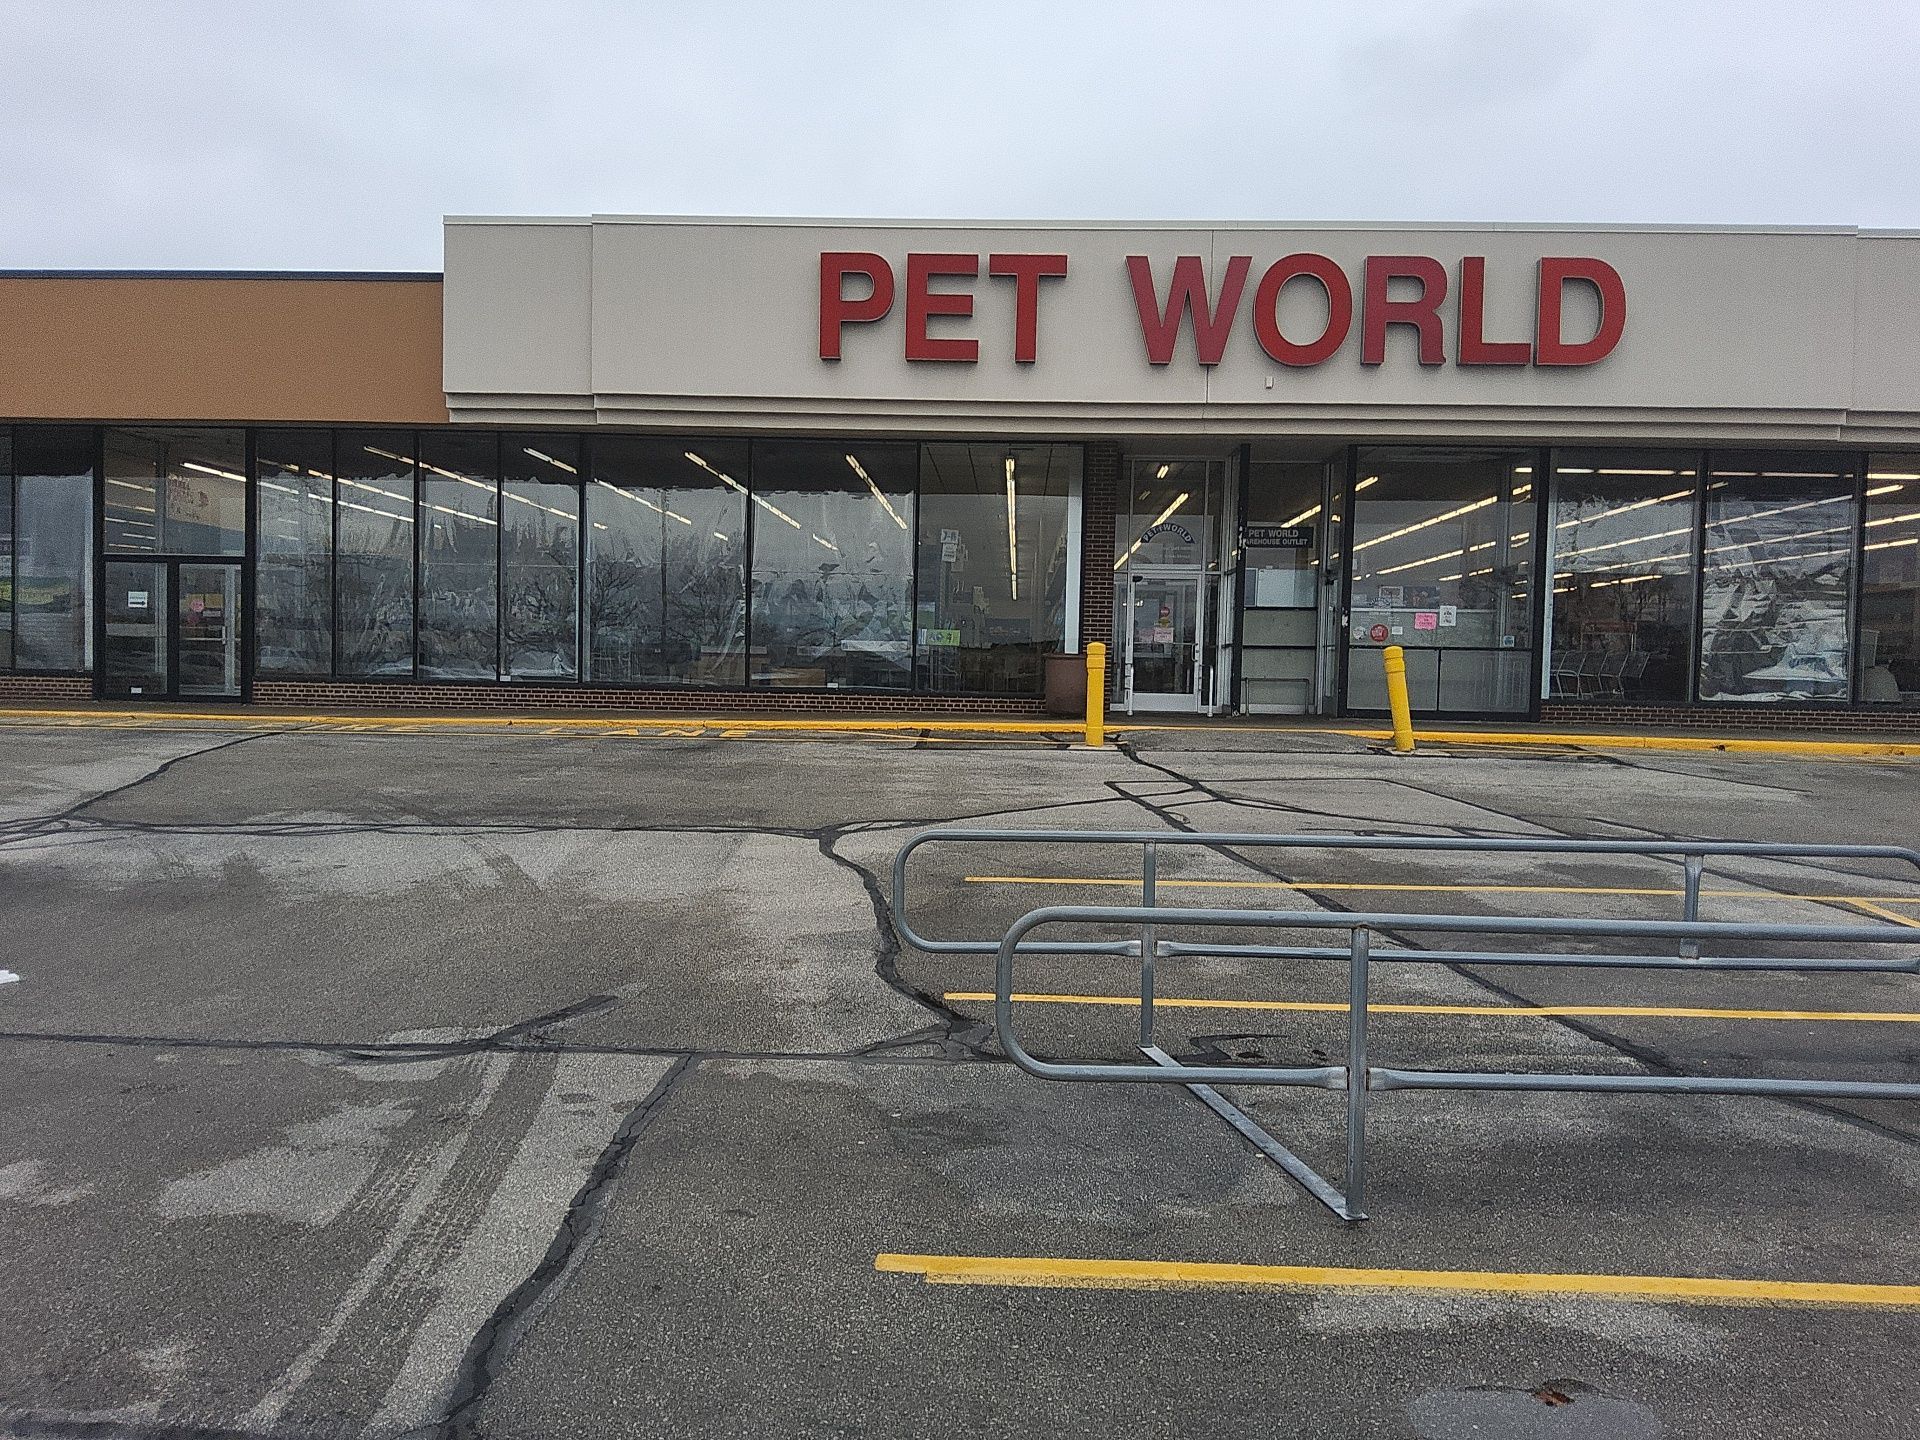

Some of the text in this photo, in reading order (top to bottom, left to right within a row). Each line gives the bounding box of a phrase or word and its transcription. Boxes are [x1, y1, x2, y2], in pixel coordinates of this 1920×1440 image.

[819, 252, 1627, 367] PET WORLD
[1163, 523, 1192, 541] WORLD
[1248, 529, 1299, 538] PET WORLD
[539, 727, 756, 737] LANE
